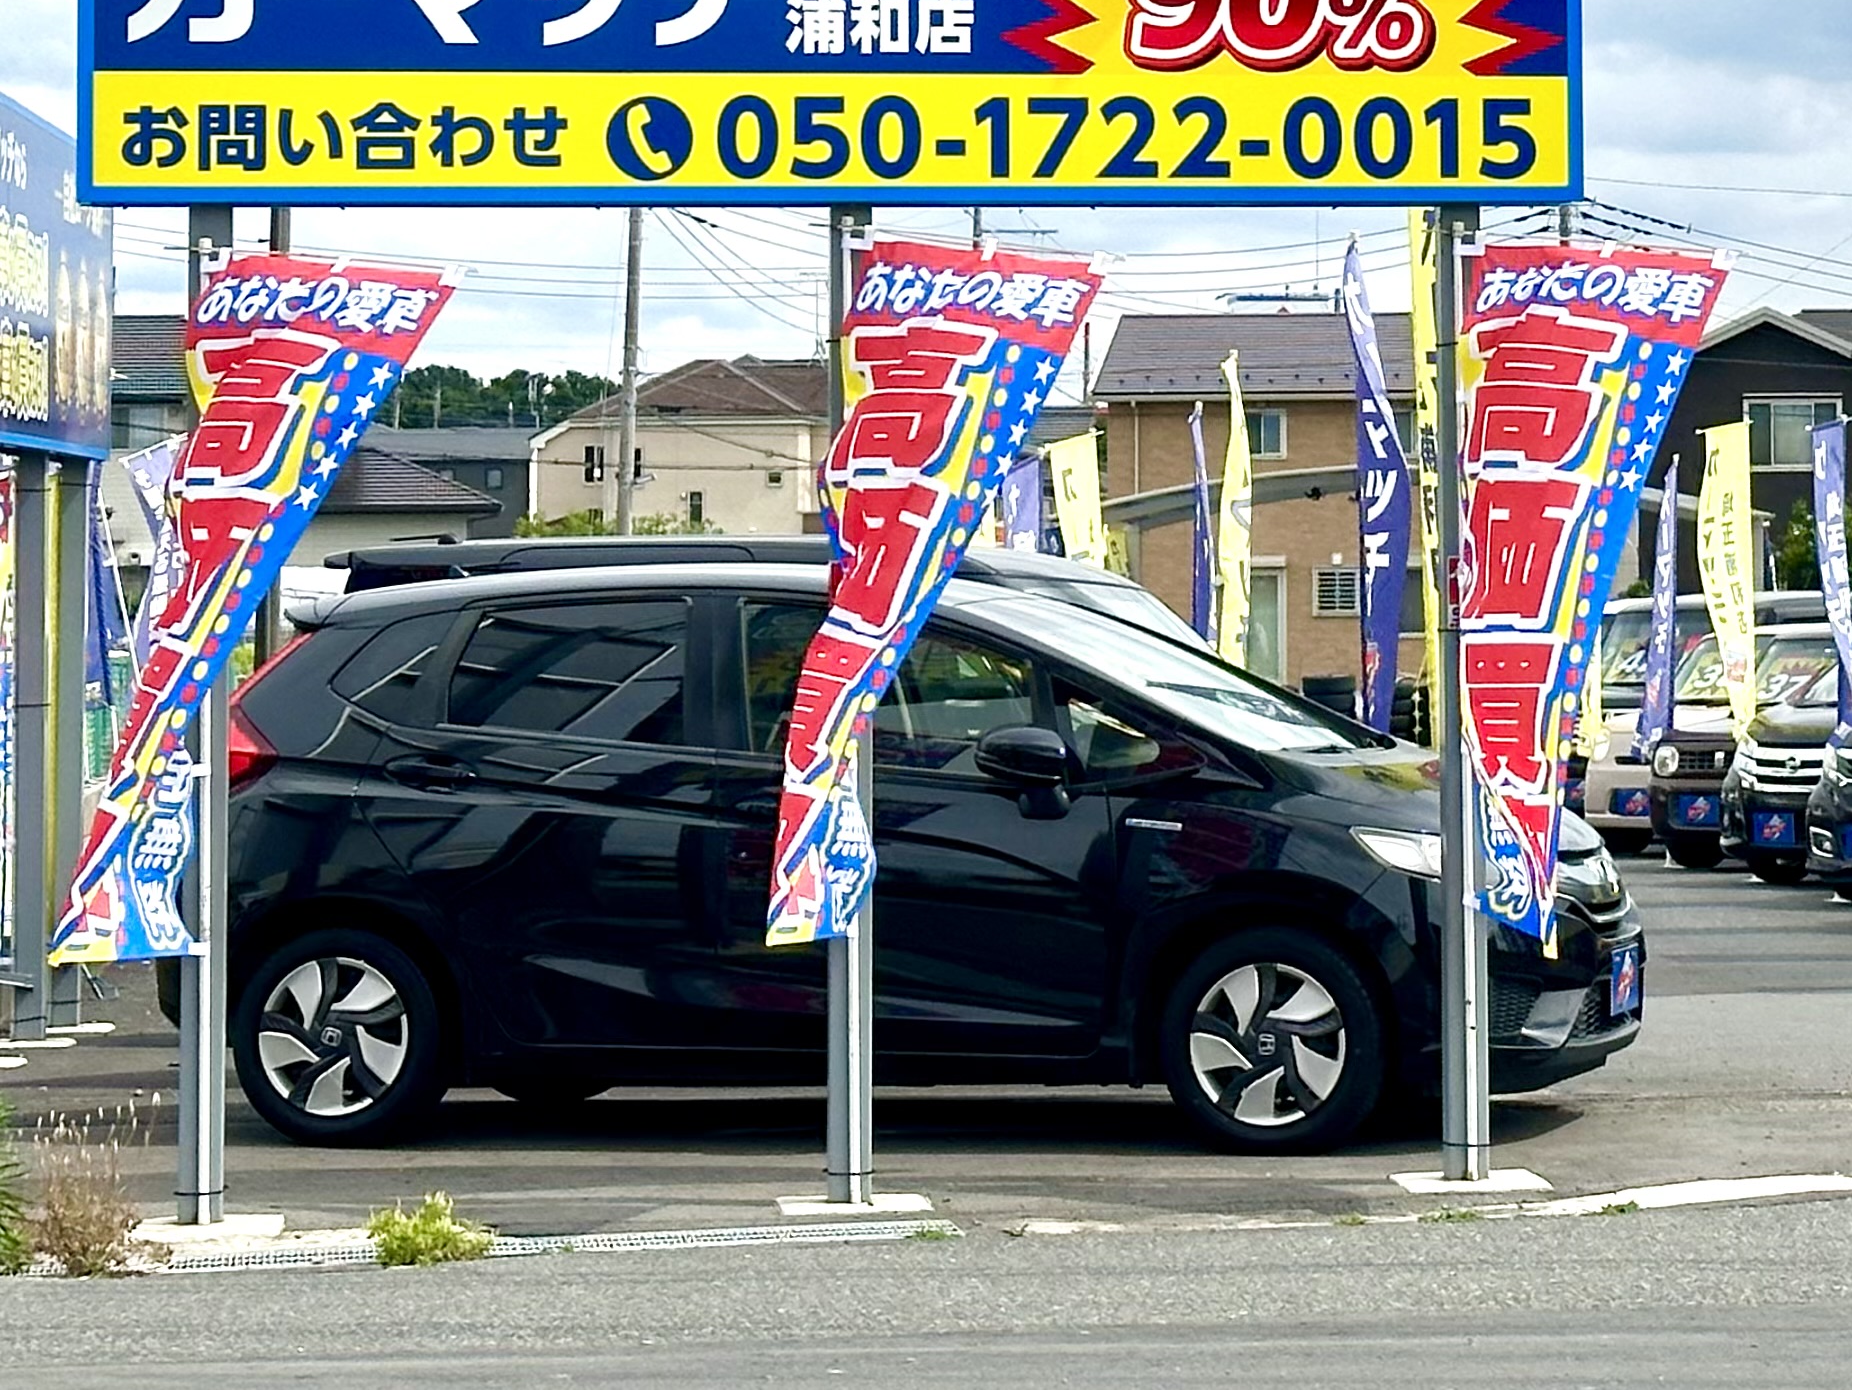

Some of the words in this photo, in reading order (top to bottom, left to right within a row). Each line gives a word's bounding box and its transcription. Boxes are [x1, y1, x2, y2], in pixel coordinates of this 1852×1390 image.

[120, 103, 568, 172] お問い合わせ
[716, 94, 1538, 180] 050-1722-0015
[197, 274, 440, 333] あなたの愛車
[856, 262, 1091, 327] あなたの愛車
[1477, 263, 1713, 322] あなたの愛車
